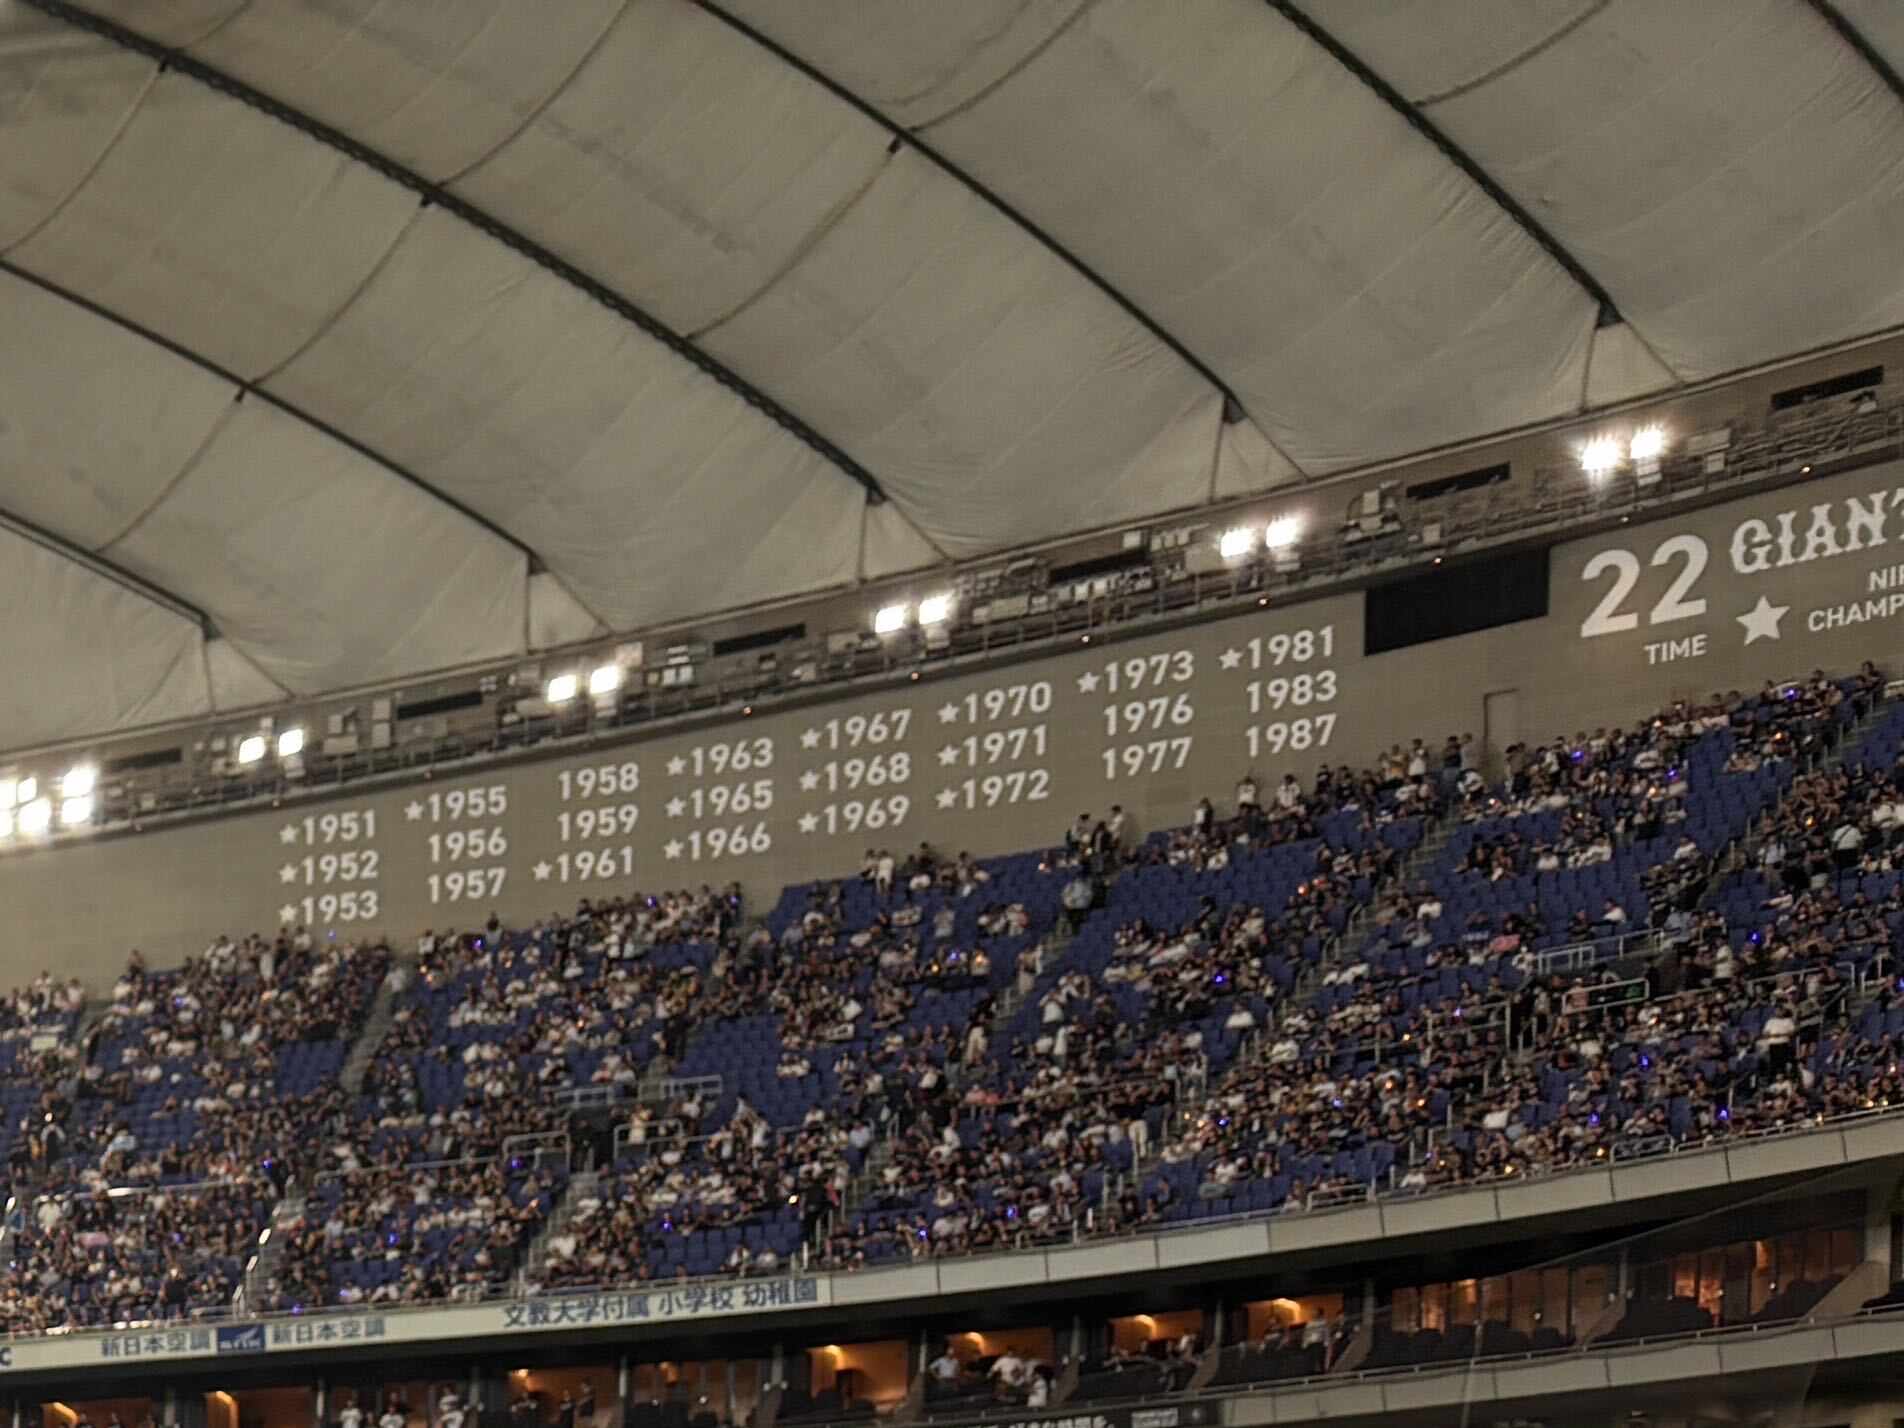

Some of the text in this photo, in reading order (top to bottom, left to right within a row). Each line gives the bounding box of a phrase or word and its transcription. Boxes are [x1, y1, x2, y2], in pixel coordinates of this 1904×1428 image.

[1580, 534, 1709, 638] 22
[1644, 634, 1708, 664] TIME
[302, 627, 1335, 847] 1951 1955 1958 1963 1967 1970 1973 1981
[302, 671, 1338, 885] 1952 1956 1959 1965 1968 1971 1976 1983
[303, 714, 1337, 925] 1953 1957 1961 1966 1969 1972 1977 1987
[101, 1330, 210, 1356] 新日本空調
[272, 1318, 385, 1344] 新日本空調
